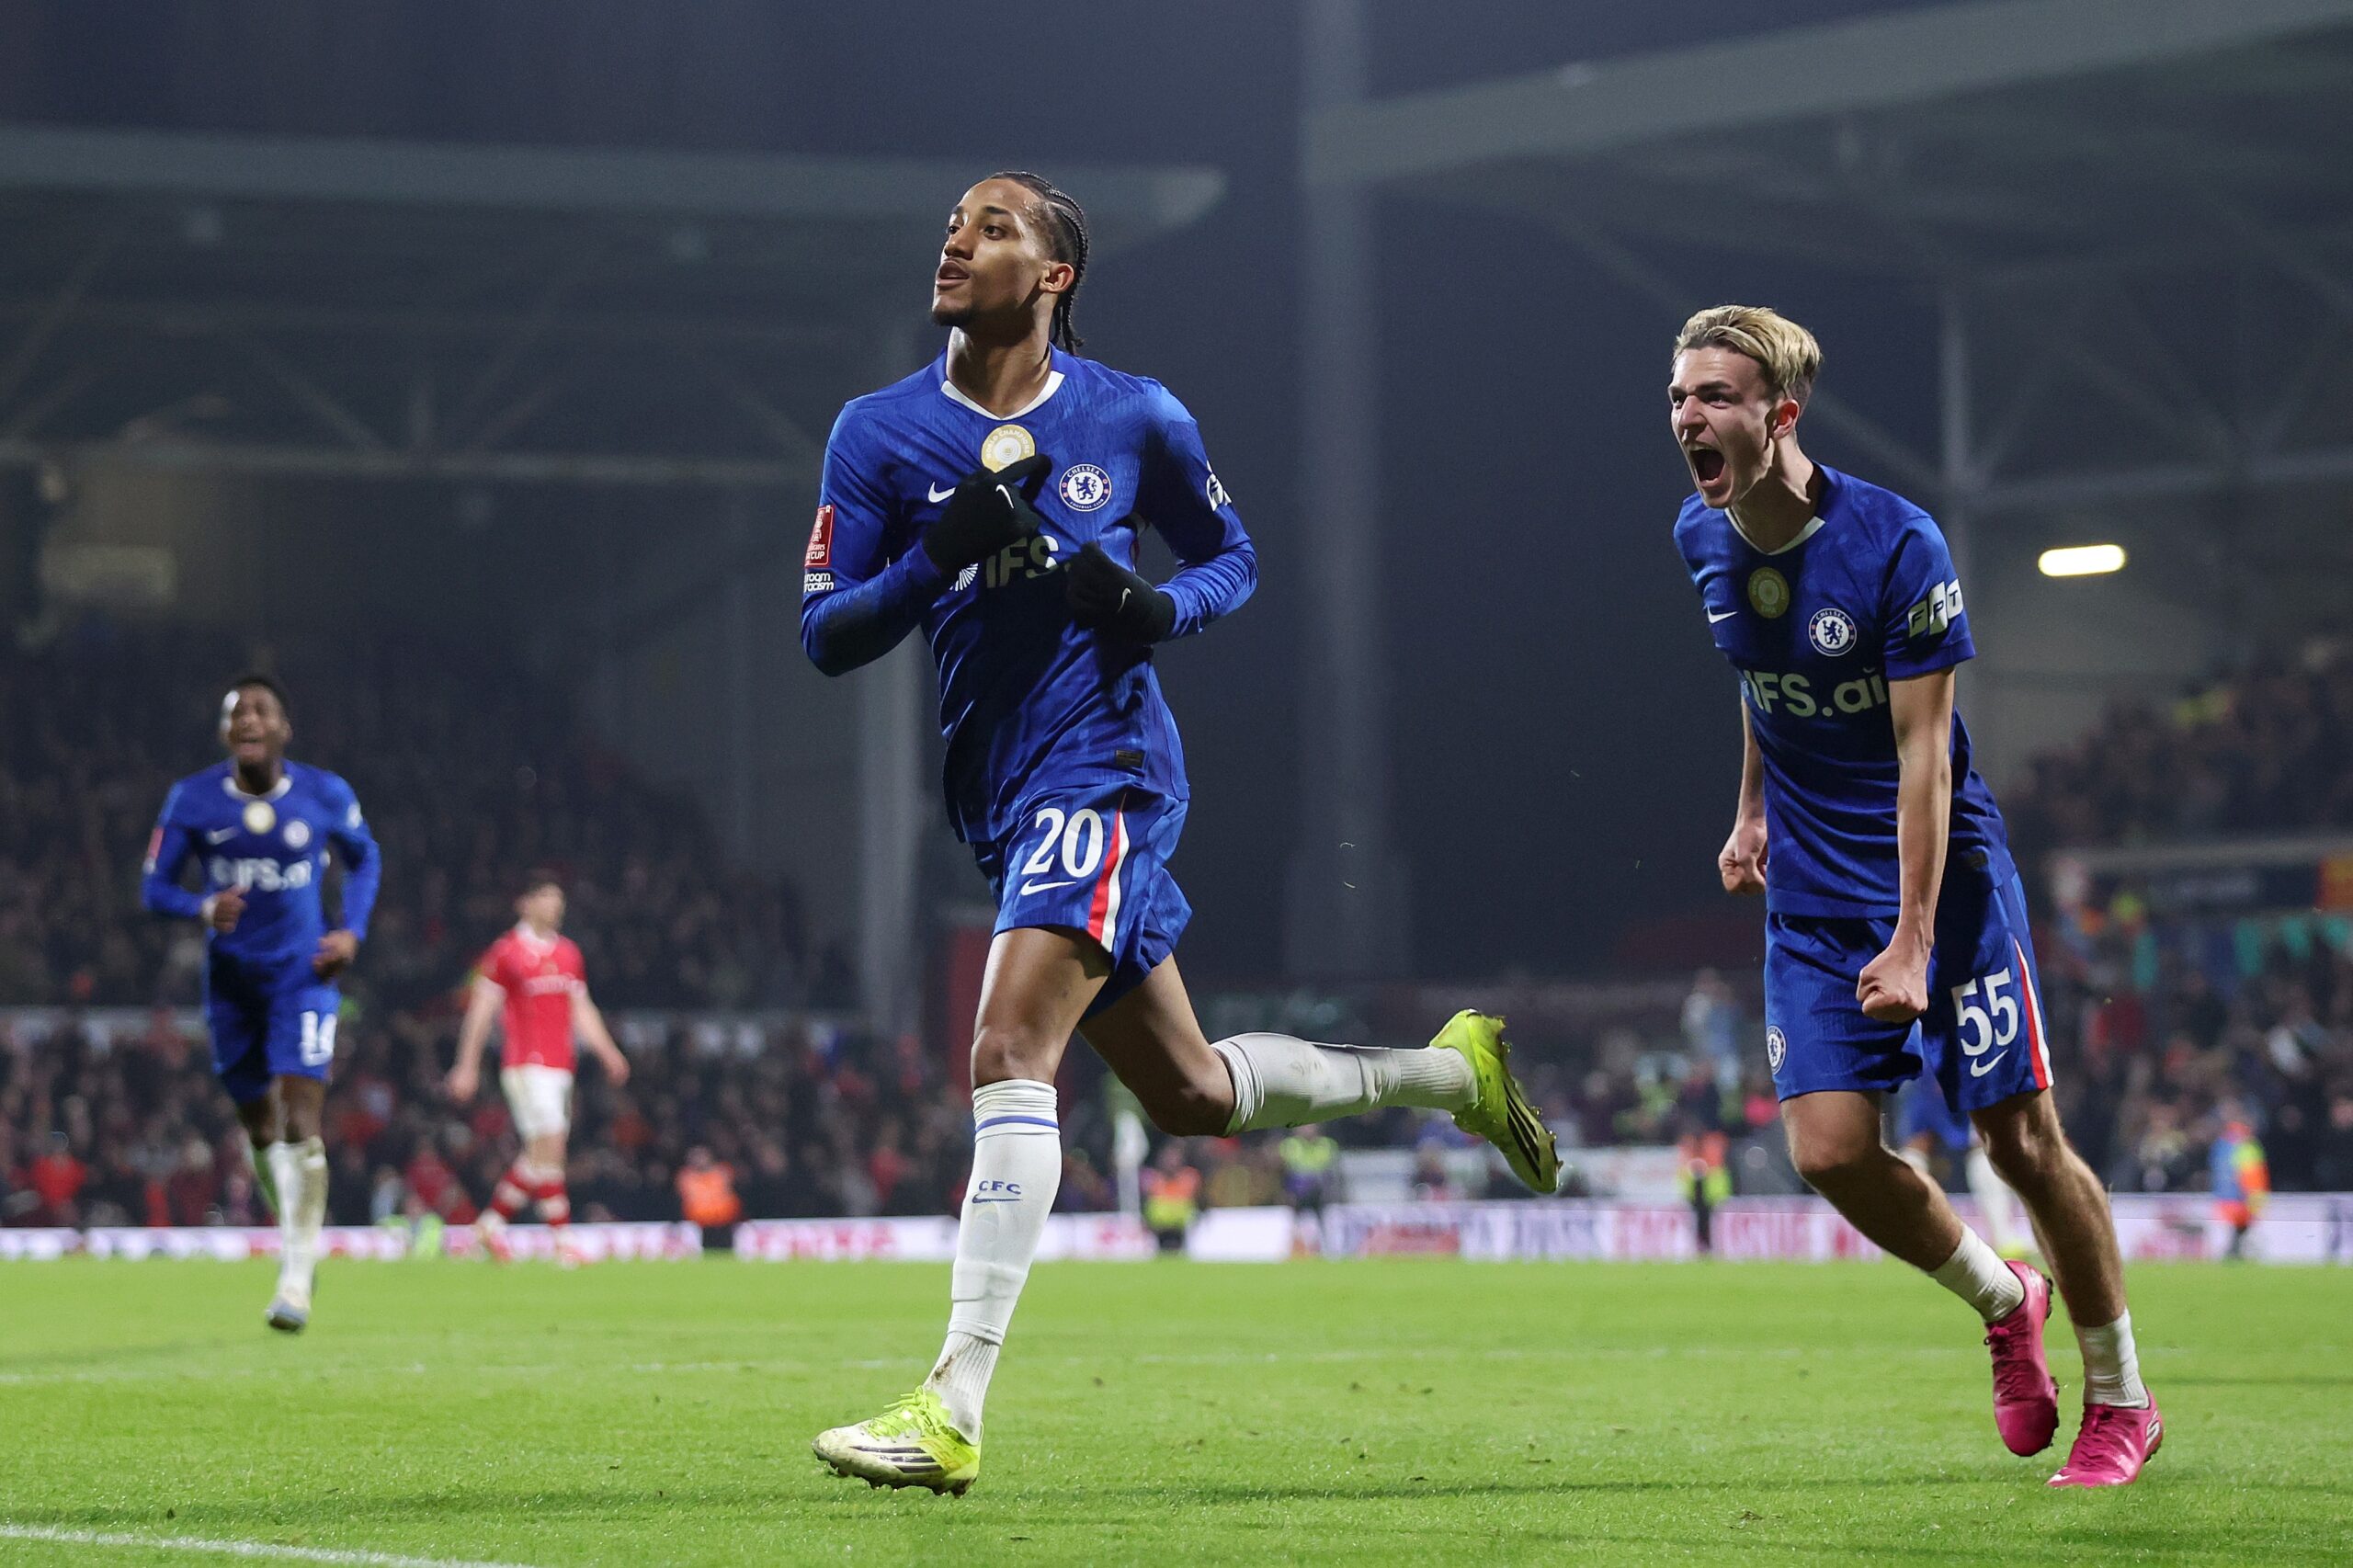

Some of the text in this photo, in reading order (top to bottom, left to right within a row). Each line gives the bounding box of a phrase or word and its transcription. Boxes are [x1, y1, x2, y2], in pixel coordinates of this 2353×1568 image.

[1066, 466, 1101, 478] CHELSEA
[1911, 588, 1960, 630] FPT
[1744, 666, 1888, 718] IFS.ai
[1020, 807, 1104, 879] 20
[1949, 966, 2019, 1057] 55
[978, 1180, 1022, 1195] CFC
